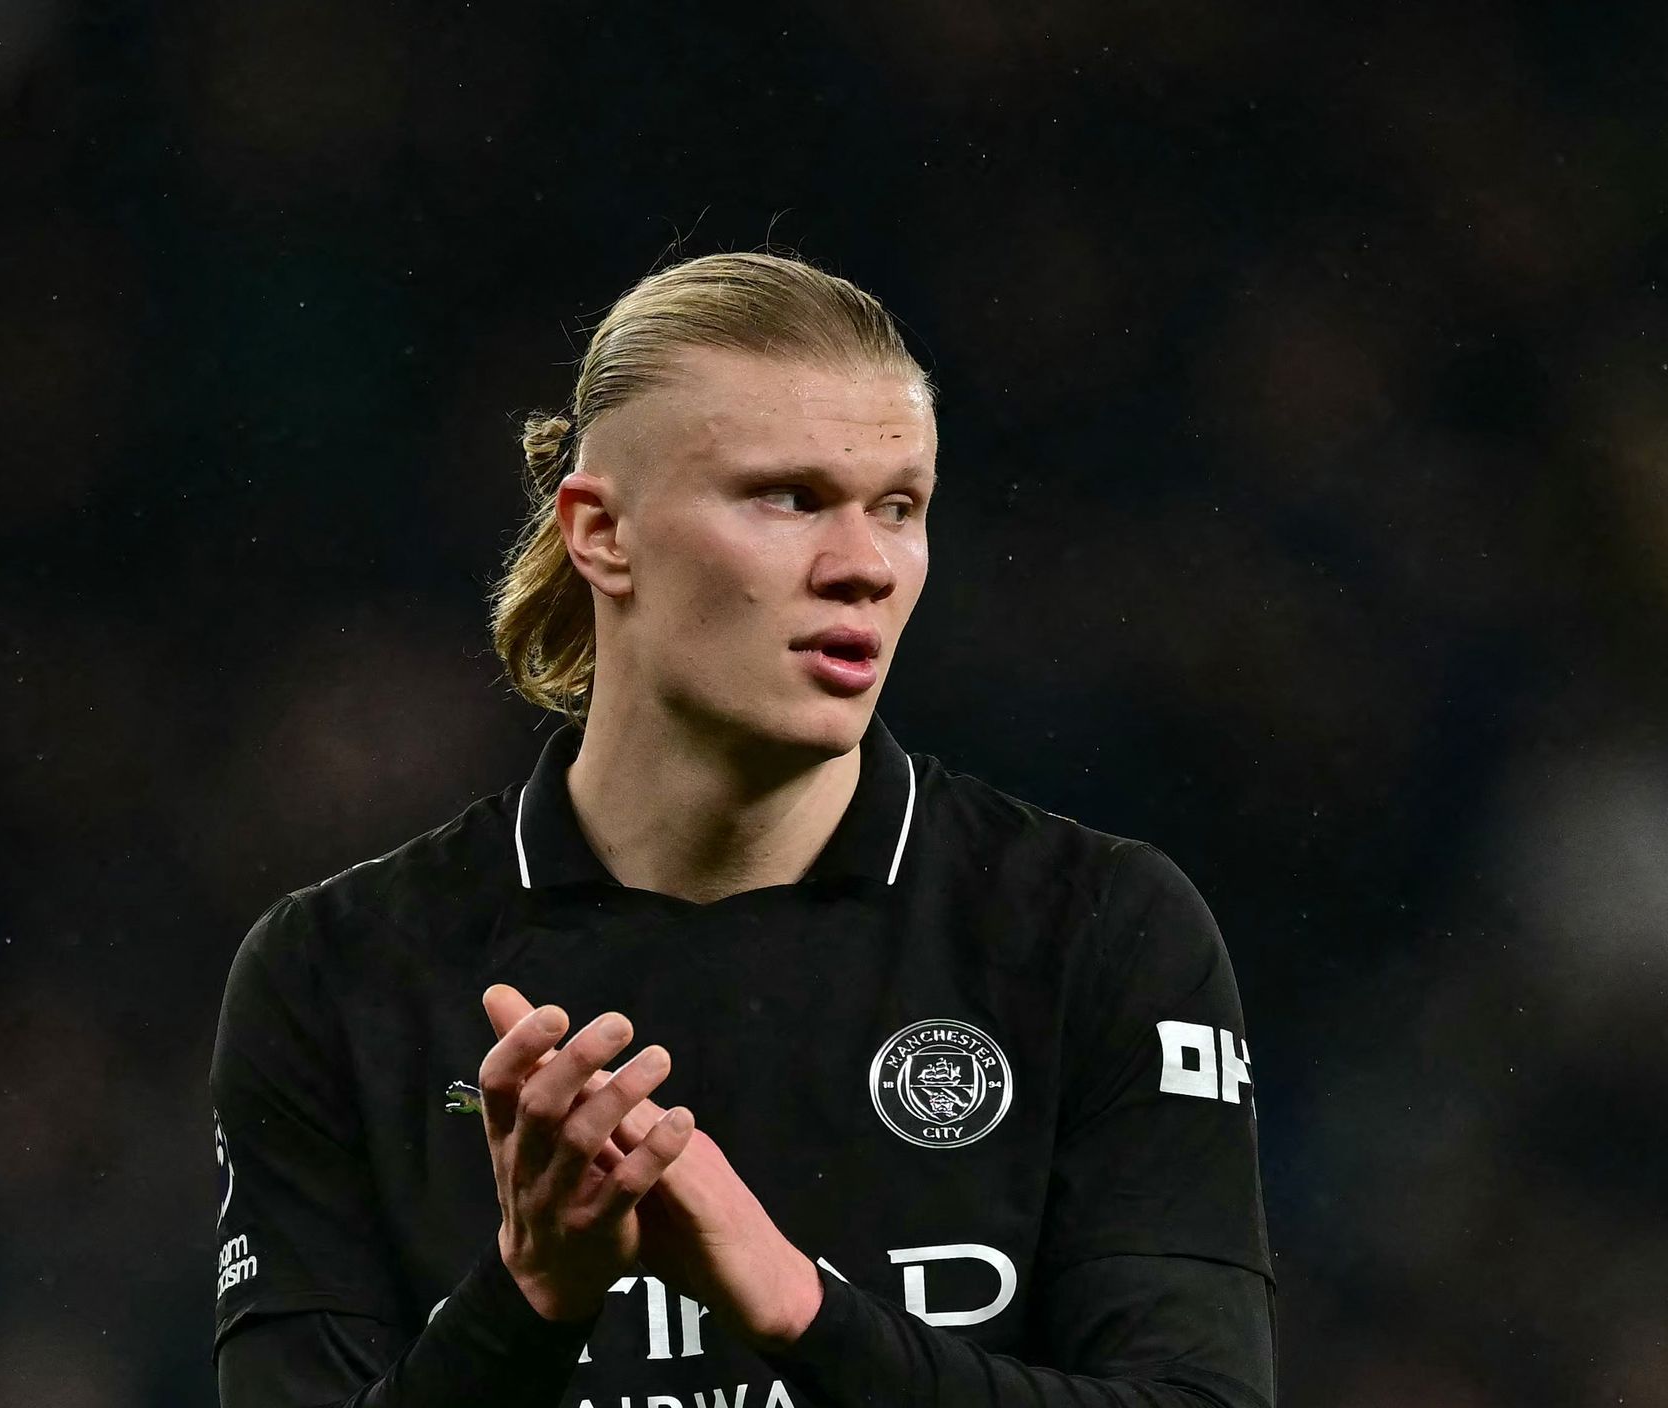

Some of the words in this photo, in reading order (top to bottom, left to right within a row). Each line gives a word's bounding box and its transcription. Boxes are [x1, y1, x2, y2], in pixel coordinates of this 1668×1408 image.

[885, 1029, 997, 1069] MANCHESTER
[882, 1080, 895, 1089] 18
[988, 1080, 1002, 1089] 94
[922, 1126, 964, 1139] CITY
